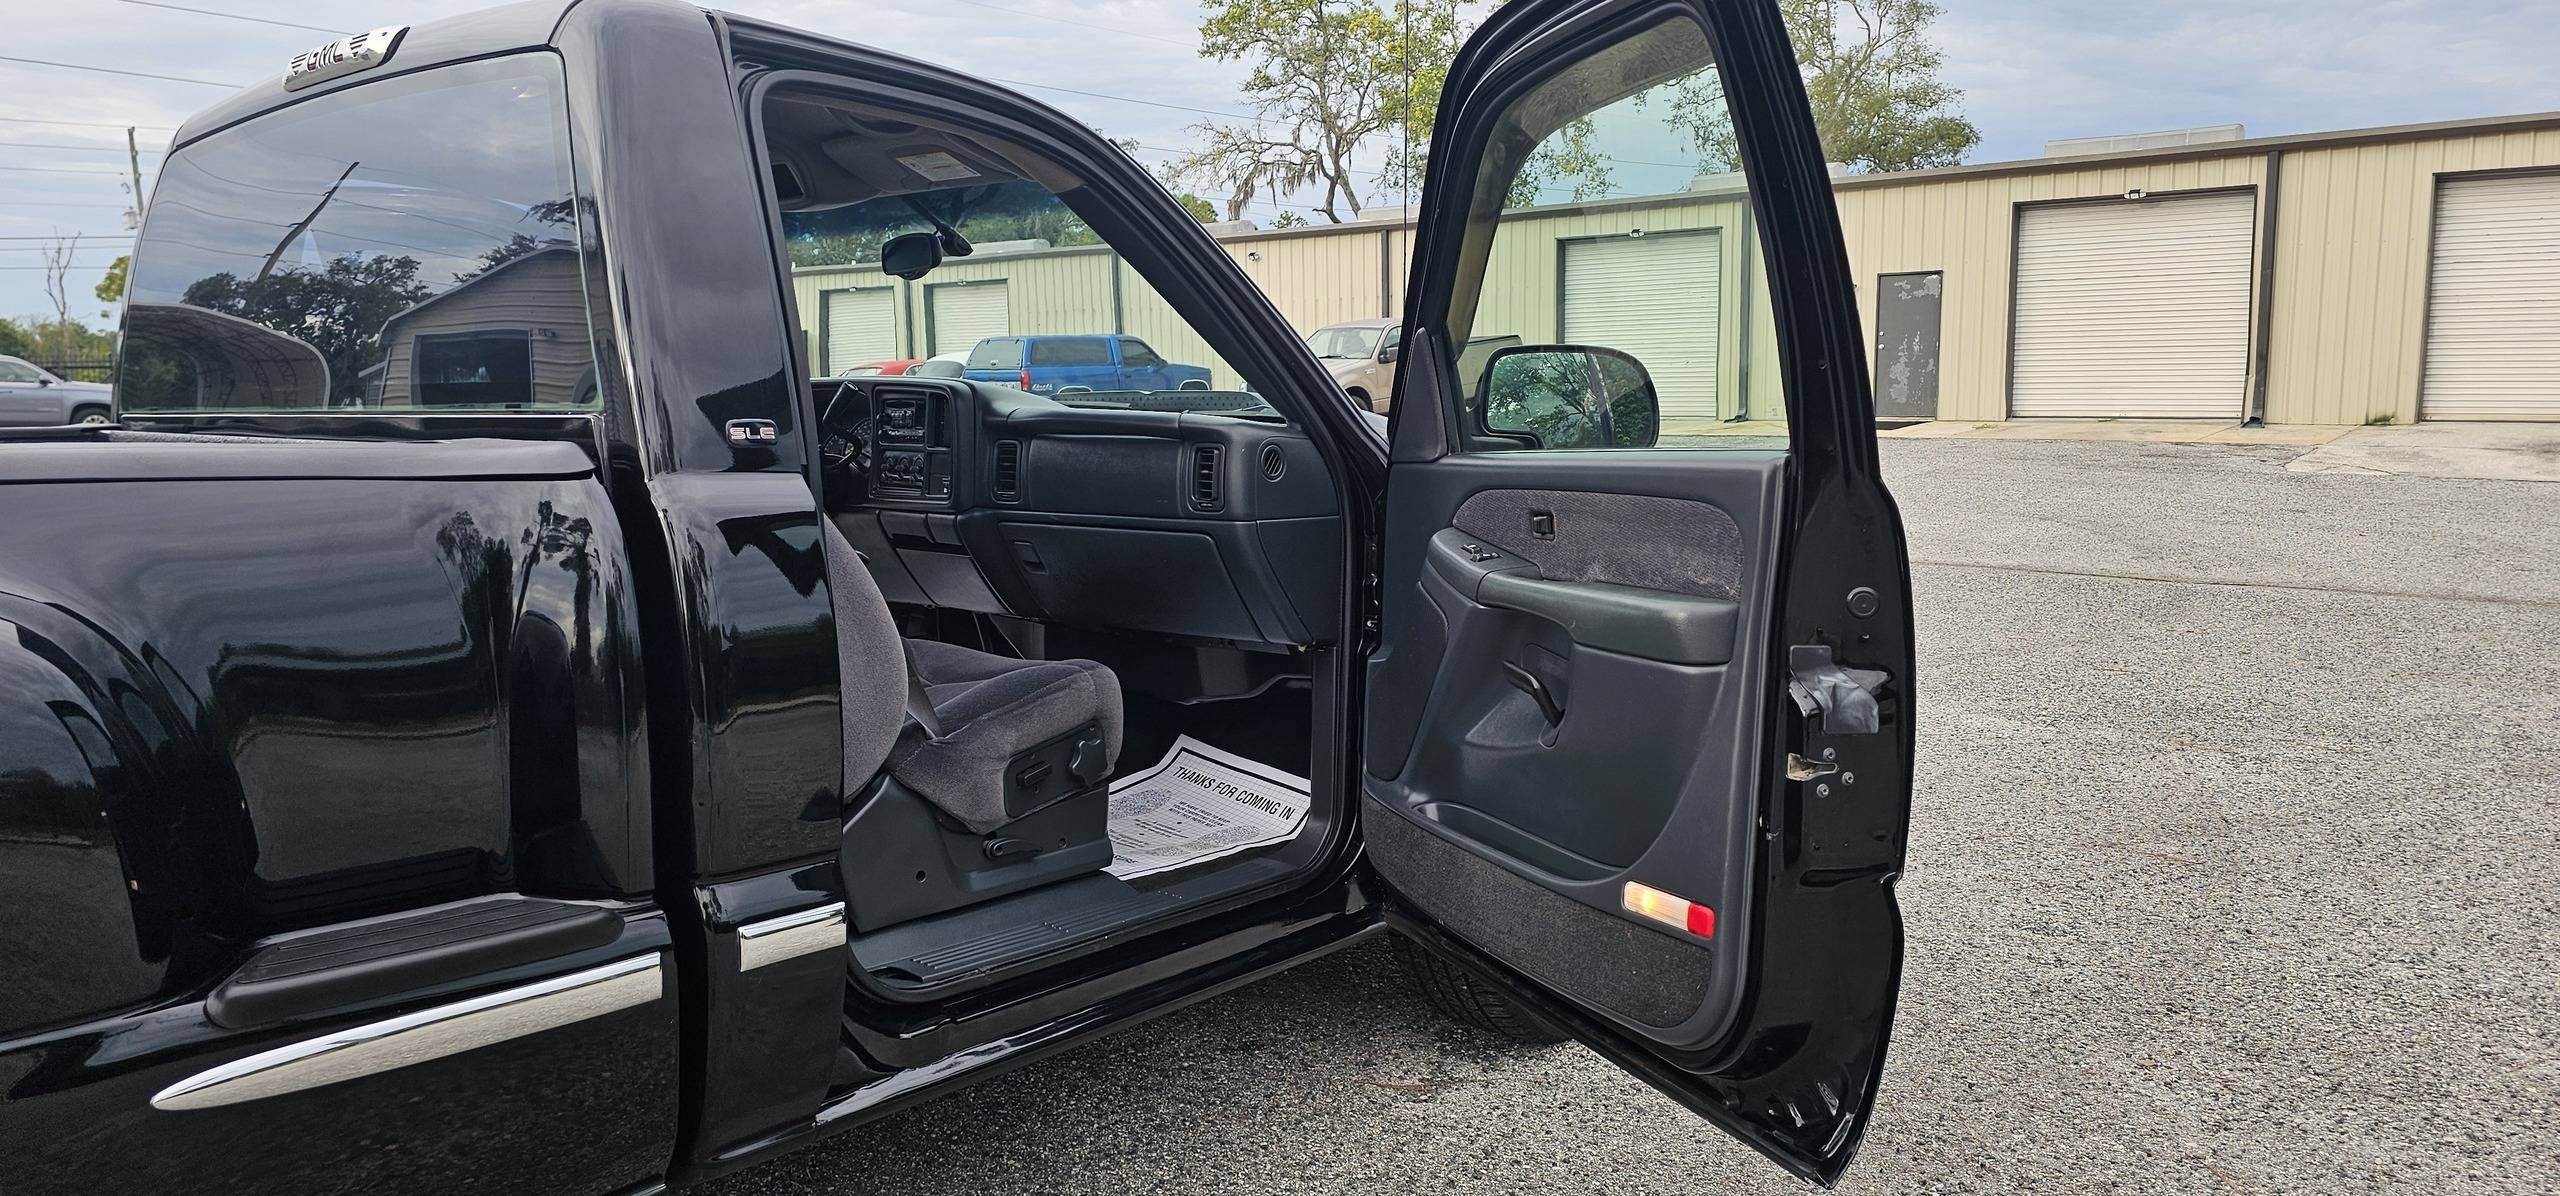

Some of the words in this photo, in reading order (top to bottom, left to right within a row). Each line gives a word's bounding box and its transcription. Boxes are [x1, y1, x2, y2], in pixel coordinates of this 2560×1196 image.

[730, 427, 776, 440] SLE
[1172, 766, 1216, 789] THANKS
[1211, 781, 1239, 799] FOR
[1235, 790, 1281, 815] COMING
[1278, 805, 1296, 821] IN
